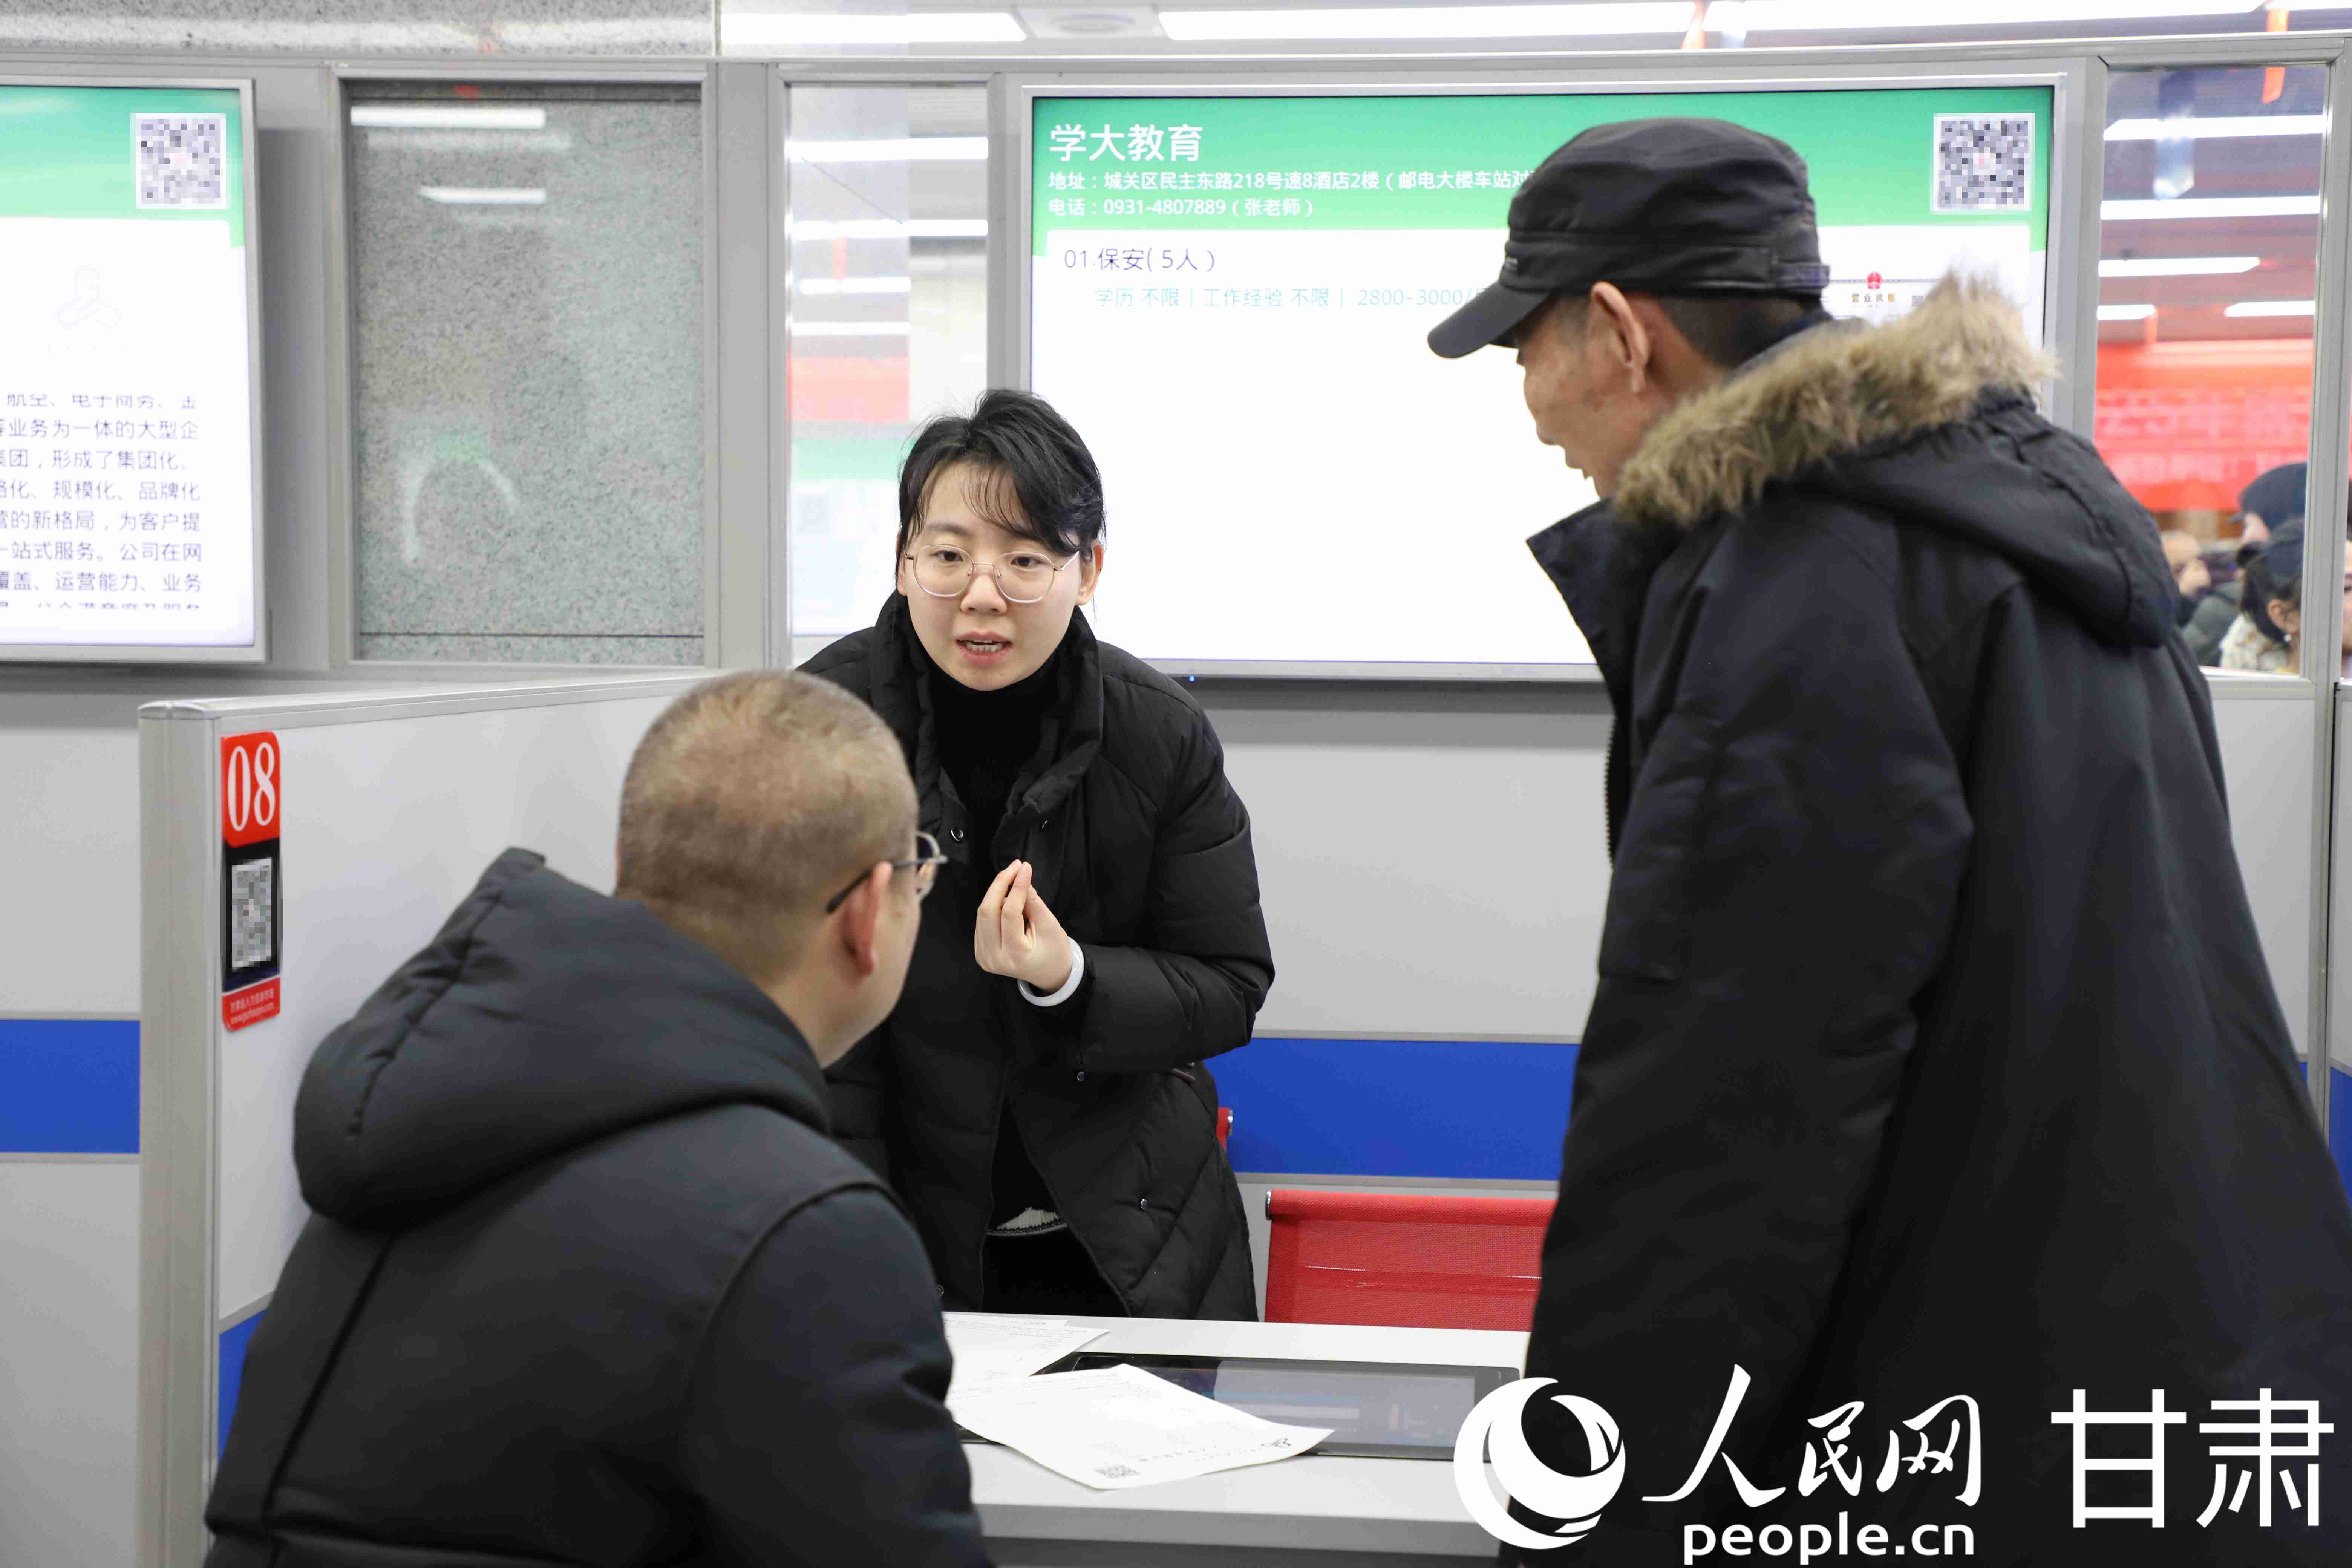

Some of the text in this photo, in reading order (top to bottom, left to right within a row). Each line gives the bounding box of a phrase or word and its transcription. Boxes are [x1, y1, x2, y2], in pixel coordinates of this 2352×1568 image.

[1050, 124, 1203, 161] 学大教育
[1049, 171, 1530, 190] 地址：城关区民主东路218号速8酒店2楼（邮电大楼车站对
[1204, 289, 1283, 307] 工作经验
[0, 418, 198, 439] 业务为一体的大型企
[227, 742, 276, 831] 08
